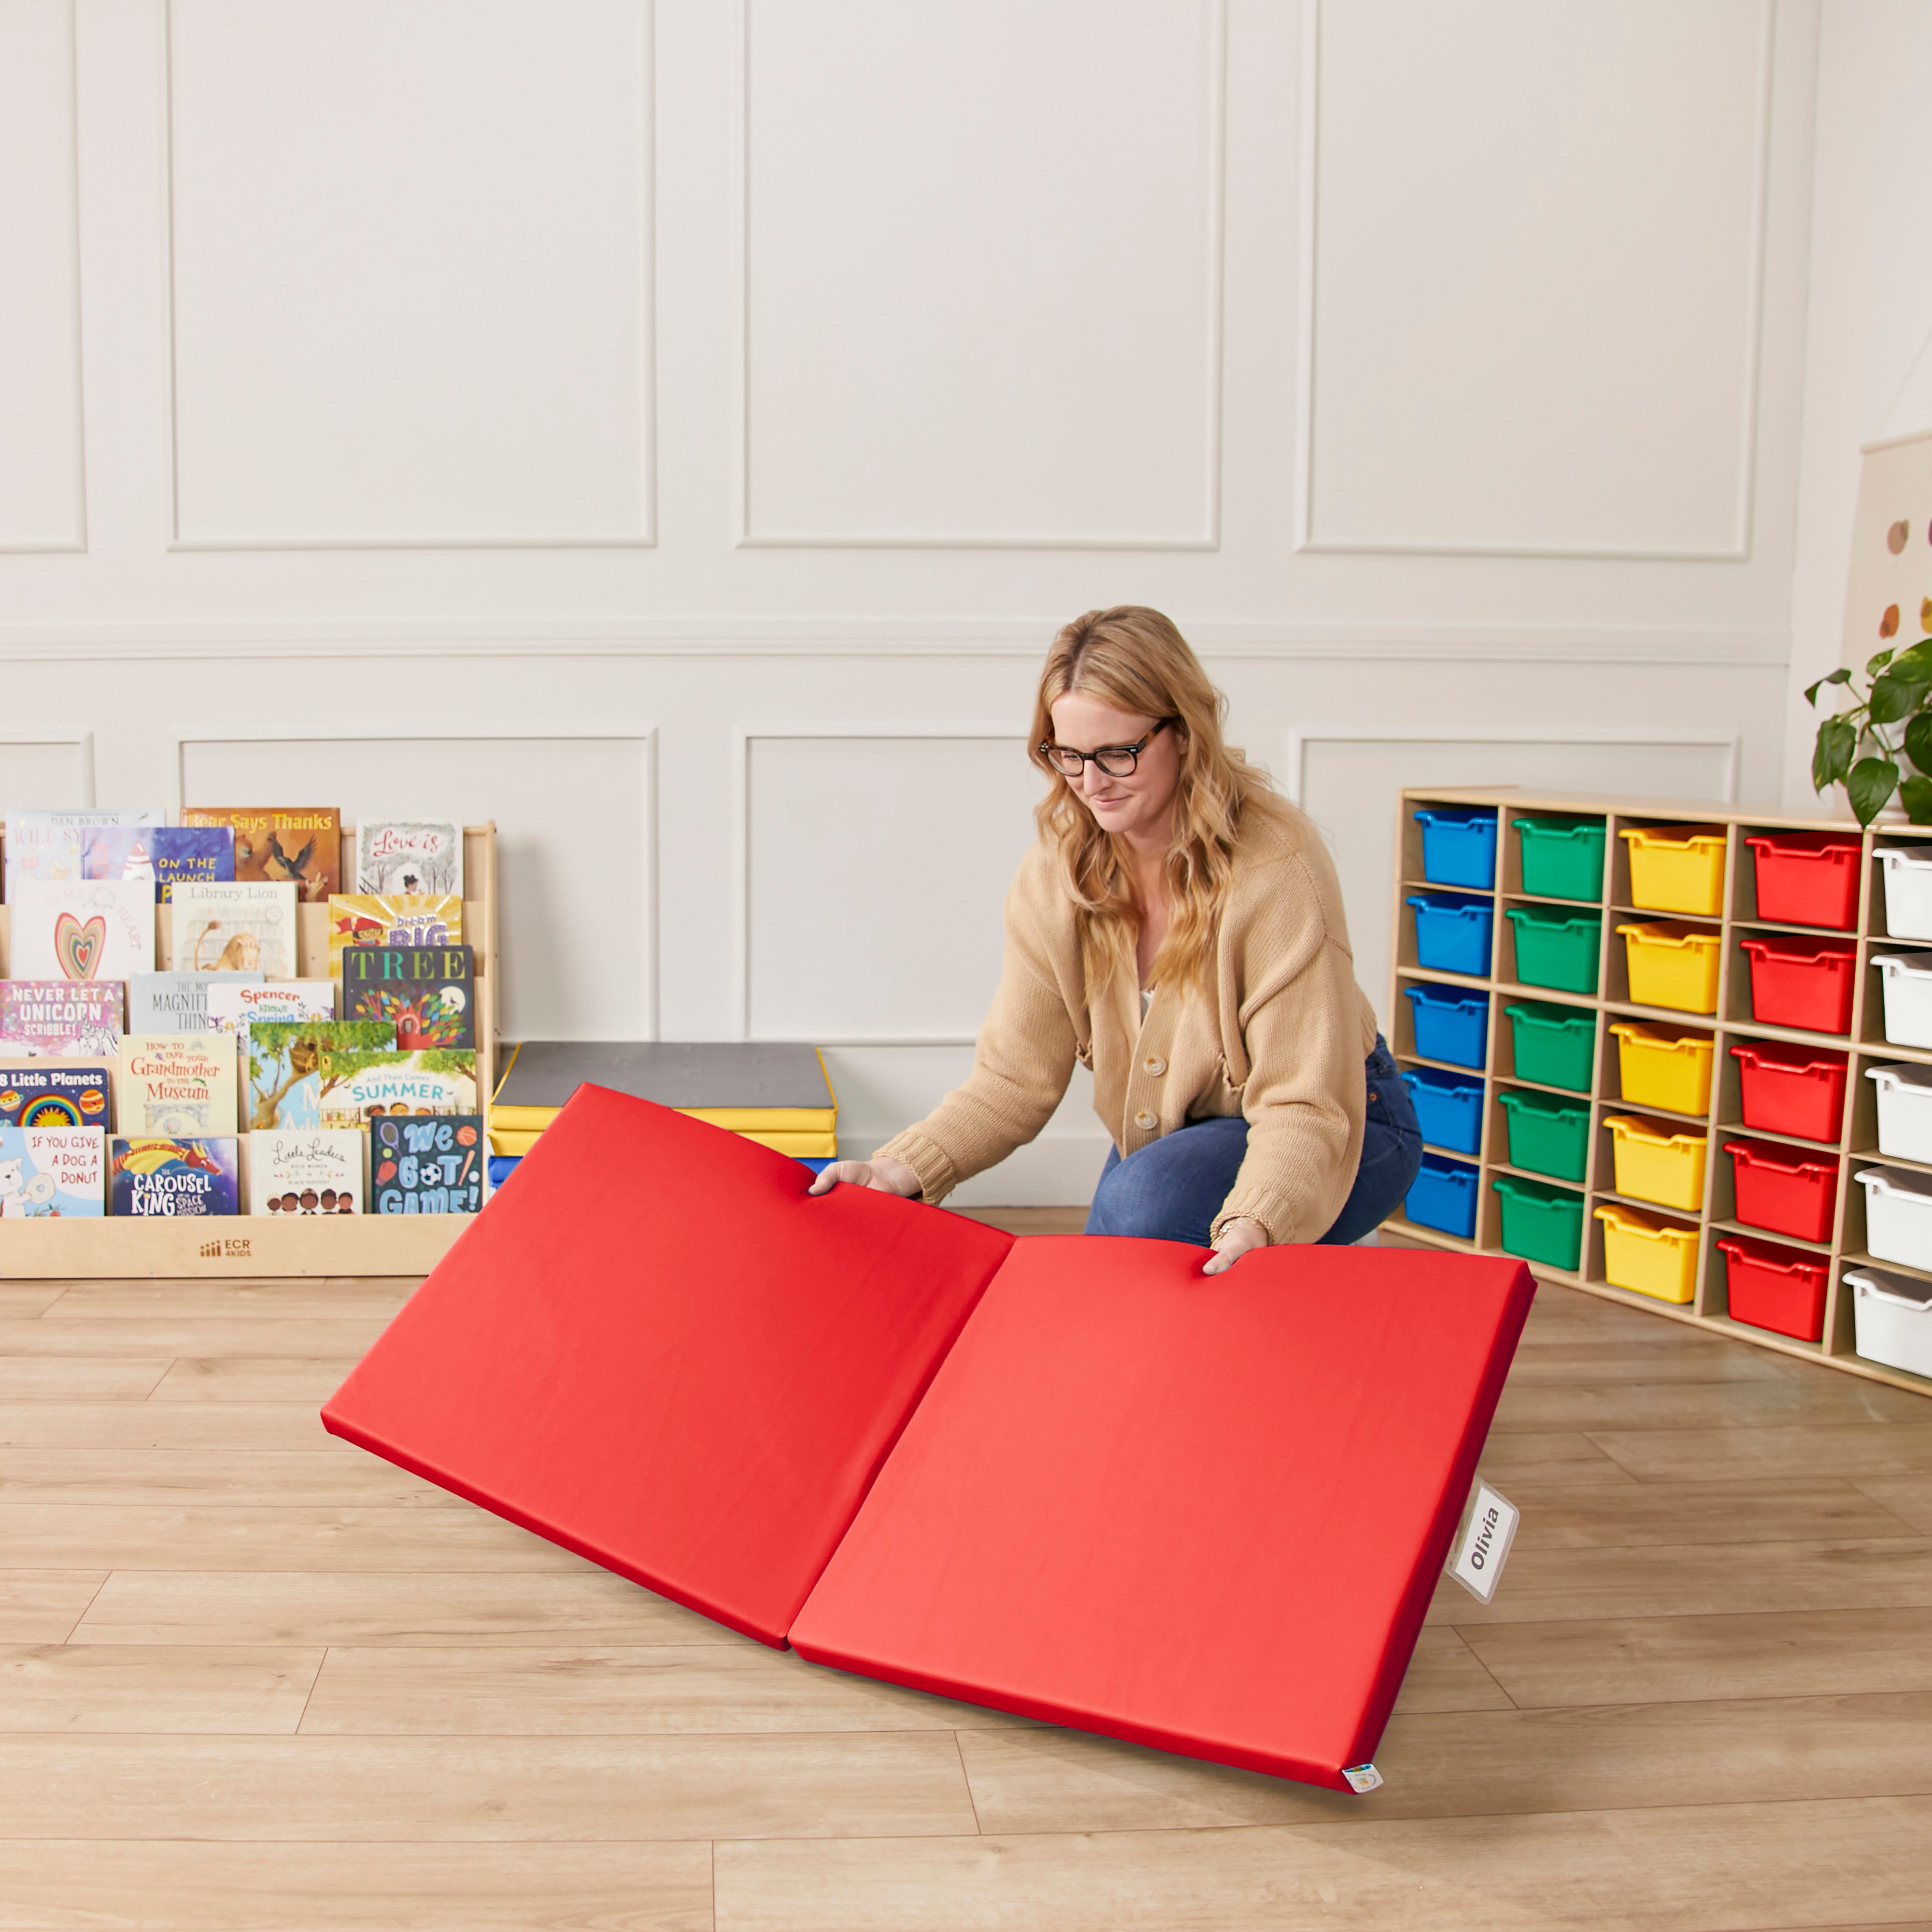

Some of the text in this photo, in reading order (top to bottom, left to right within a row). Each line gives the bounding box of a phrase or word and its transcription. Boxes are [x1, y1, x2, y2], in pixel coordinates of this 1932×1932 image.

[51, 817, 120, 826] DAN BROWN
[188, 813, 332, 835] Bear Says Thanks
[373, 829, 440, 857] Love is
[158, 857, 216, 869] ON THE
[159, 872, 215, 882] LAUNCH
[190, 887, 277, 902] Library Lion
[116, 905, 142, 950] HEART
[397, 914, 436, 927] Dream
[388, 922, 448, 947] BIG
[351, 951, 466, 980] TREE
[176, 981, 208, 992] THE MO
[12, 987, 115, 1002] NEVER LET A
[240, 990, 300, 1004] Spencer
[20, 1003, 101, 1021] UNICORN
[176, 1012, 208, 1029] THIN
[25, 1023, 76, 1036] SCRIBBLE!
[172, 1042, 185, 1051] TO
[131, 1056, 220, 1077] Grandmother
[0, 1072, 103, 1087] 8 Little Planets
[367, 1074, 381, 1082] And
[147, 1082, 211, 1102] Museum
[352, 1083, 443, 1102] SUMMER
[31, 1136, 99, 1149] IF YOU GIVE
[403, 1121, 454, 1153] We
[272, 1137, 346, 1165] Little Leaders
[52, 1153, 98, 1166] A DOG A
[61, 1171, 98, 1184] DONUT
[134, 1173, 212, 1193] CAROUSEL
[131, 1190, 175, 1216] KING
[176, 1194, 203, 1209] SPACE
[379, 1186, 480, 1214] GAME!
[225, 1239, 250, 1249] ECR
[1471, 1507, 1499, 1570] Olivia
